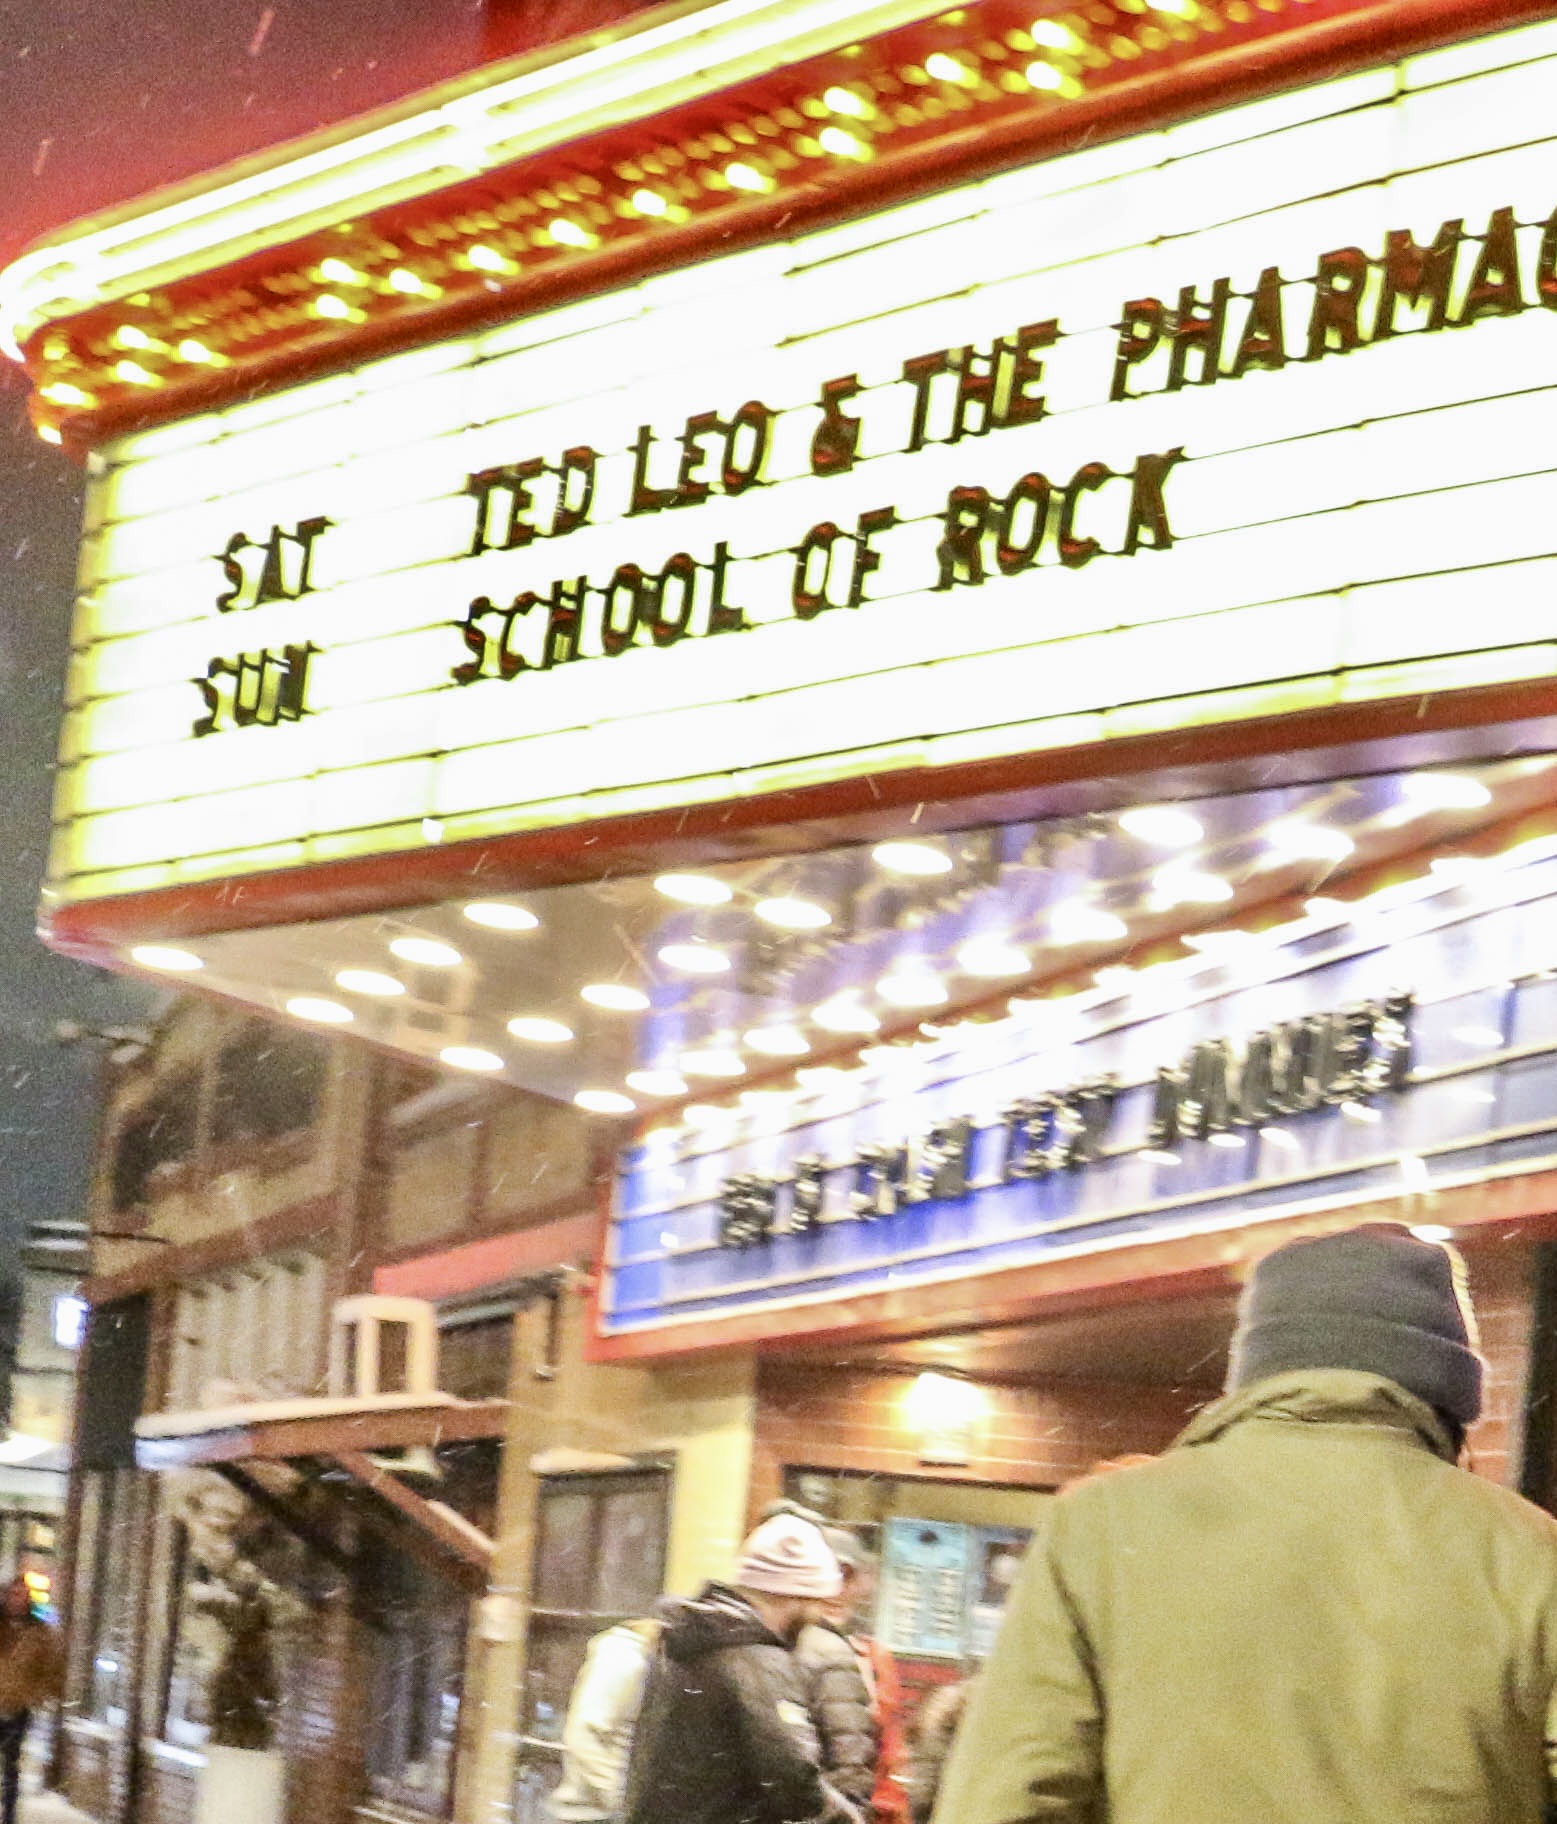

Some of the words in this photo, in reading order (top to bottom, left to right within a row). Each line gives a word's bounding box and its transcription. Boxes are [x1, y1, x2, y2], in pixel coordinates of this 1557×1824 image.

[192, 640, 324, 738] SUN
[452, 541, 752, 681] SCHOOL
[792, 506, 897, 620] OF
[932, 446, 1187, 589] ROCK
[216, 516, 334, 613] SAT
[468, 446, 594, 556] TED
[631, 401, 769, 517] LEO
[811, 374, 860, 473] &
[904, 319, 1060, 453] THE
